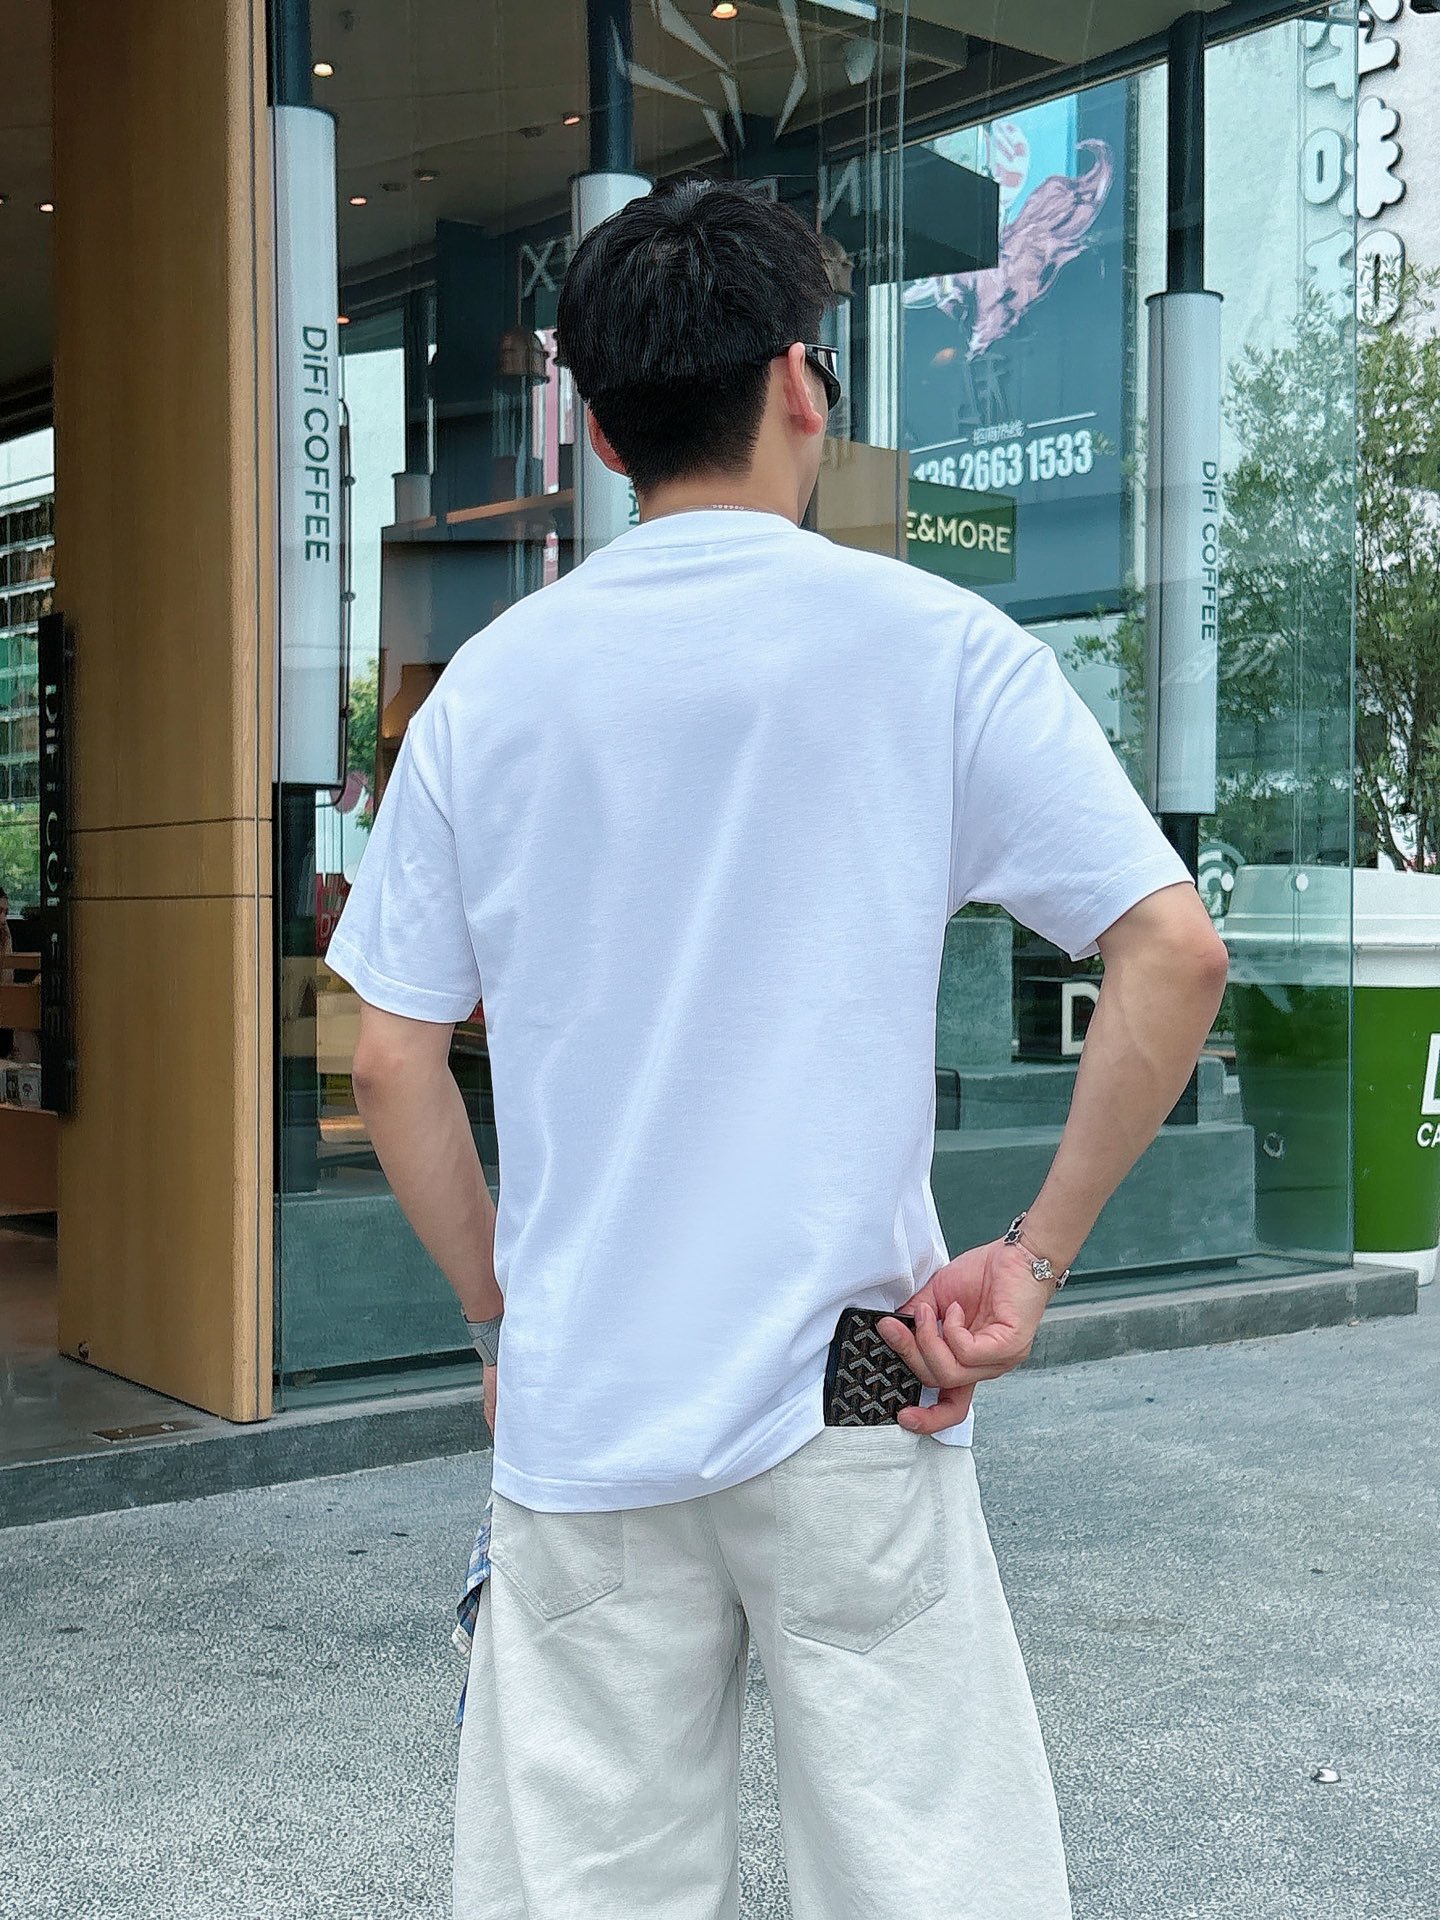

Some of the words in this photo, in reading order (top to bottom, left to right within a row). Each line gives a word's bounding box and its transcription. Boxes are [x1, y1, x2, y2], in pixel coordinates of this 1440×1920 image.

[302, 326, 329, 396] DiFi
[303, 408, 330, 563] COFFEE
[959, 443, 1024, 492] 2663
[1026, 430, 1094, 482] 1533
[1201, 523, 1218, 641] COFFEE
